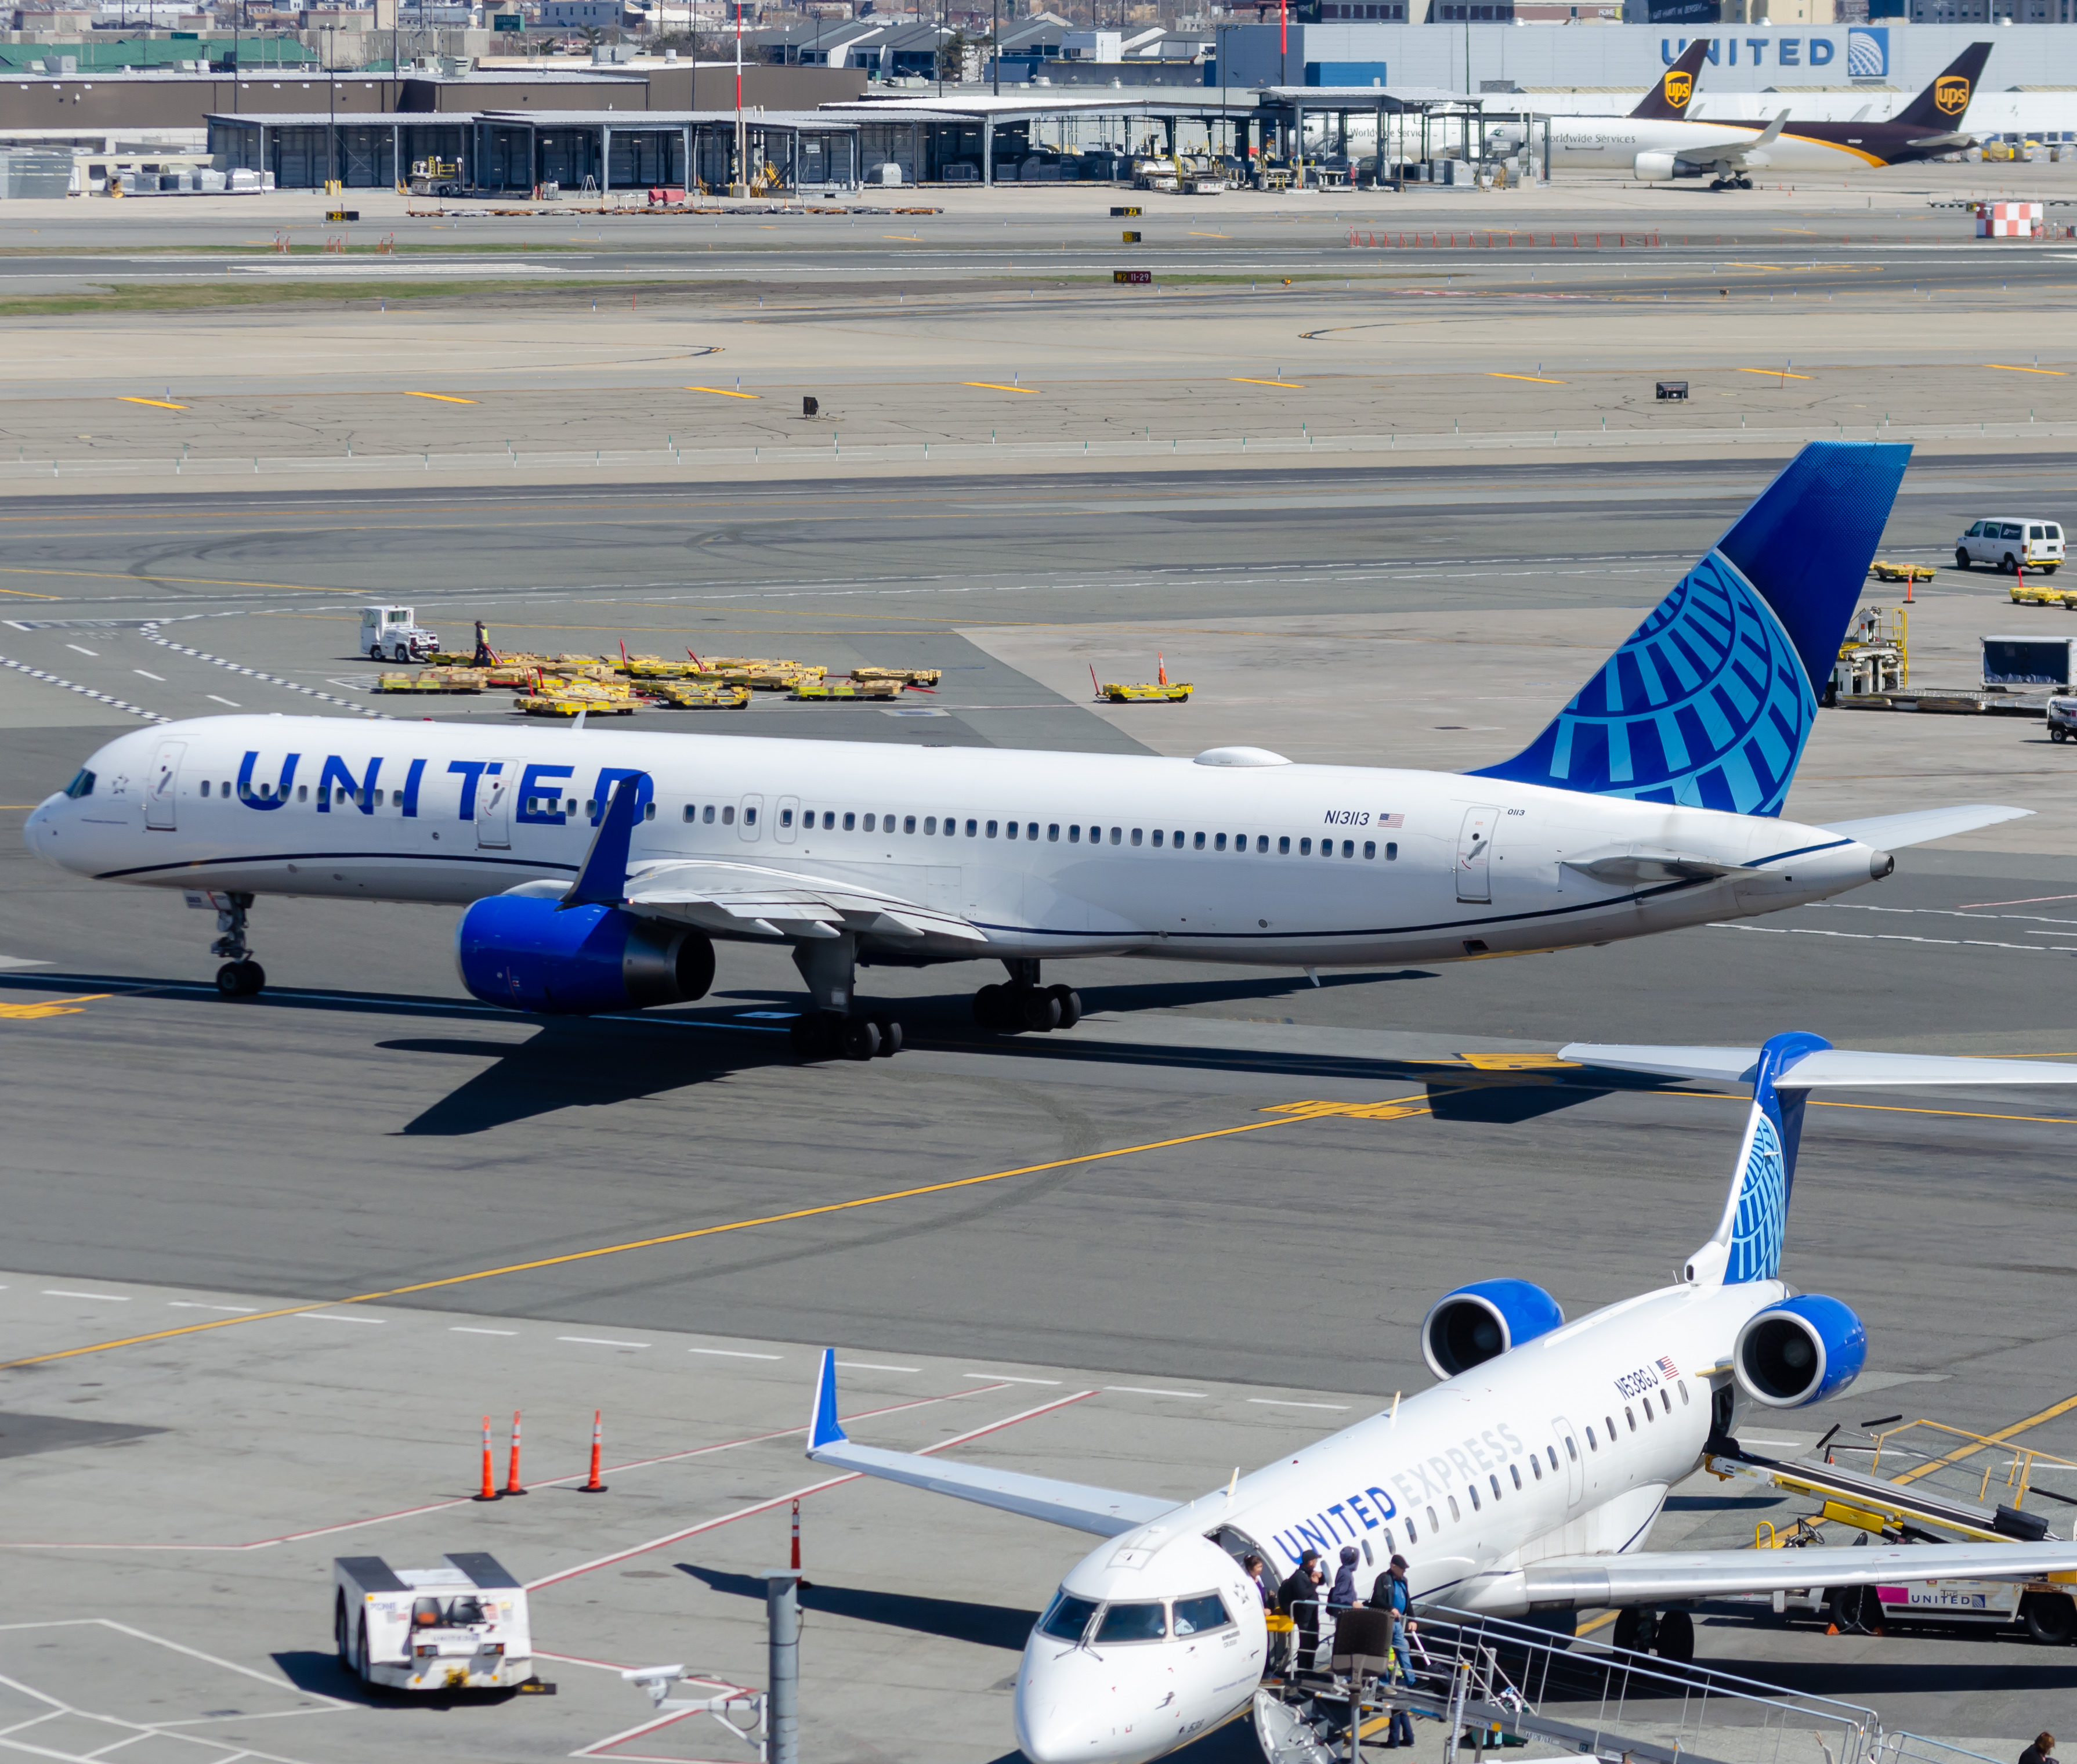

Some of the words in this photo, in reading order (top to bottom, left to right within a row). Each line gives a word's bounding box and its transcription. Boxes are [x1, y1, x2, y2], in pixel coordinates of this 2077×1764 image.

[1595, 133, 1636, 143] Services
[237, 750, 654, 827] UNITED
[1324, 810, 1370, 826] N13113
[1613, 1365, 1659, 1400] N538GJ
[1272, 1486, 1397, 1565] UNITED
[1390, 1422, 1524, 1509] EXPRESS
[1912, 1595, 1970, 1605] UNITED
